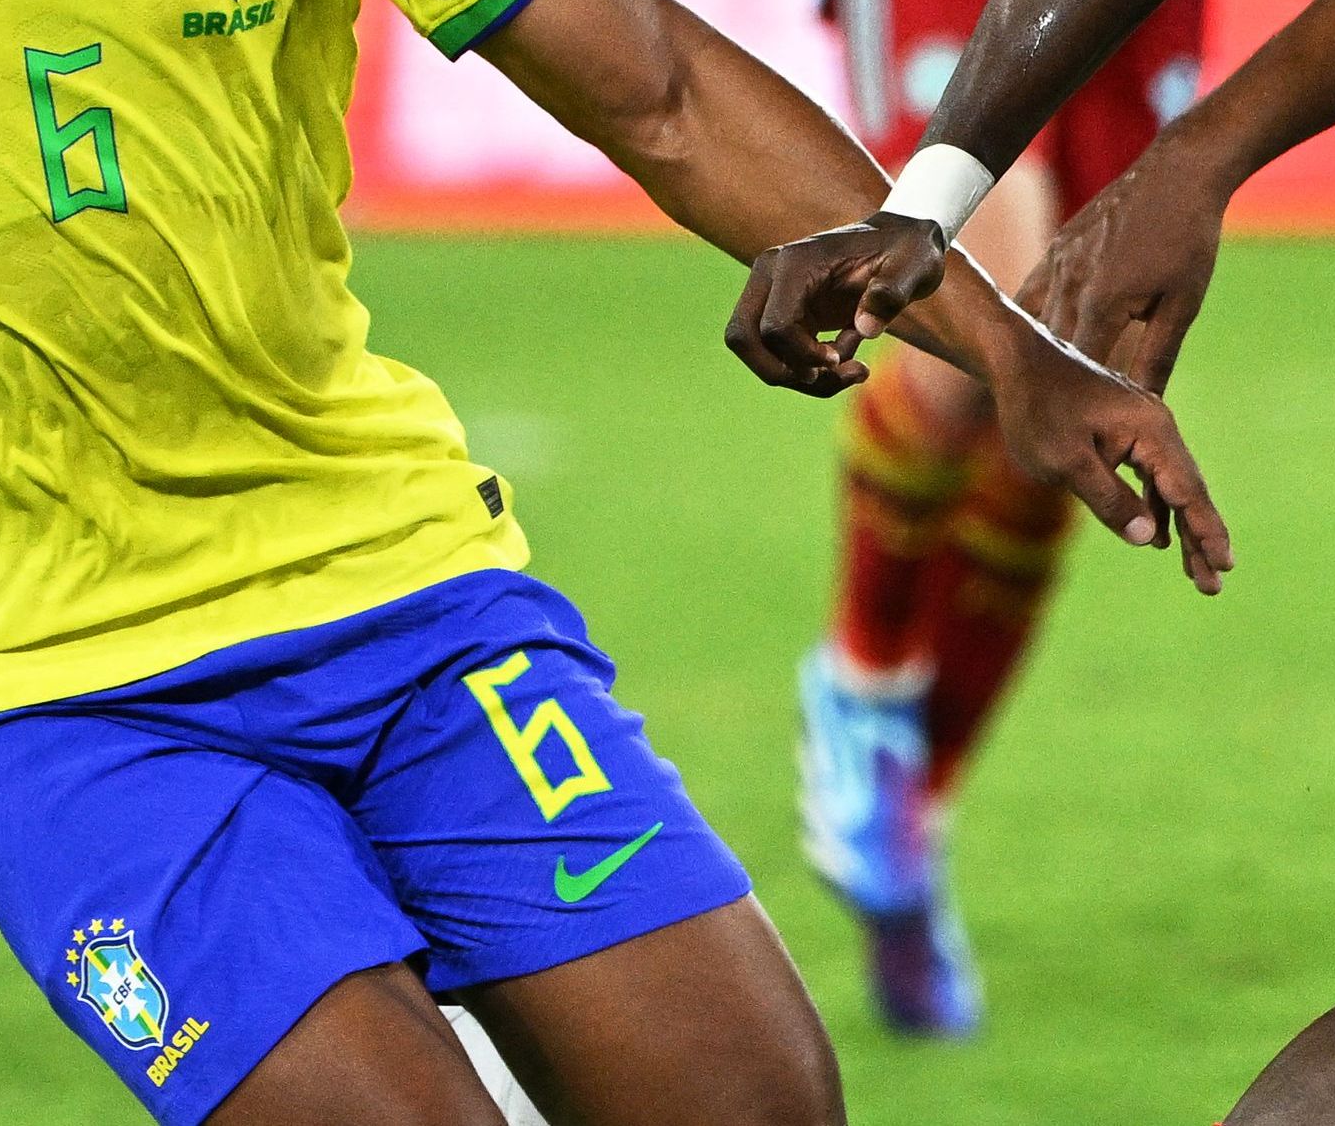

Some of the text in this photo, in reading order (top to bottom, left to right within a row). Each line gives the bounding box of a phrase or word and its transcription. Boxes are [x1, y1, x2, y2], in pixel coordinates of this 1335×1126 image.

[182, 0, 277, 38] BRASIL
[24, 42, 128, 224] 6
[462, 650, 613, 823] 6
[113, 978, 133, 1005] CBF
[146, 1017, 211, 1087] BRASIL
